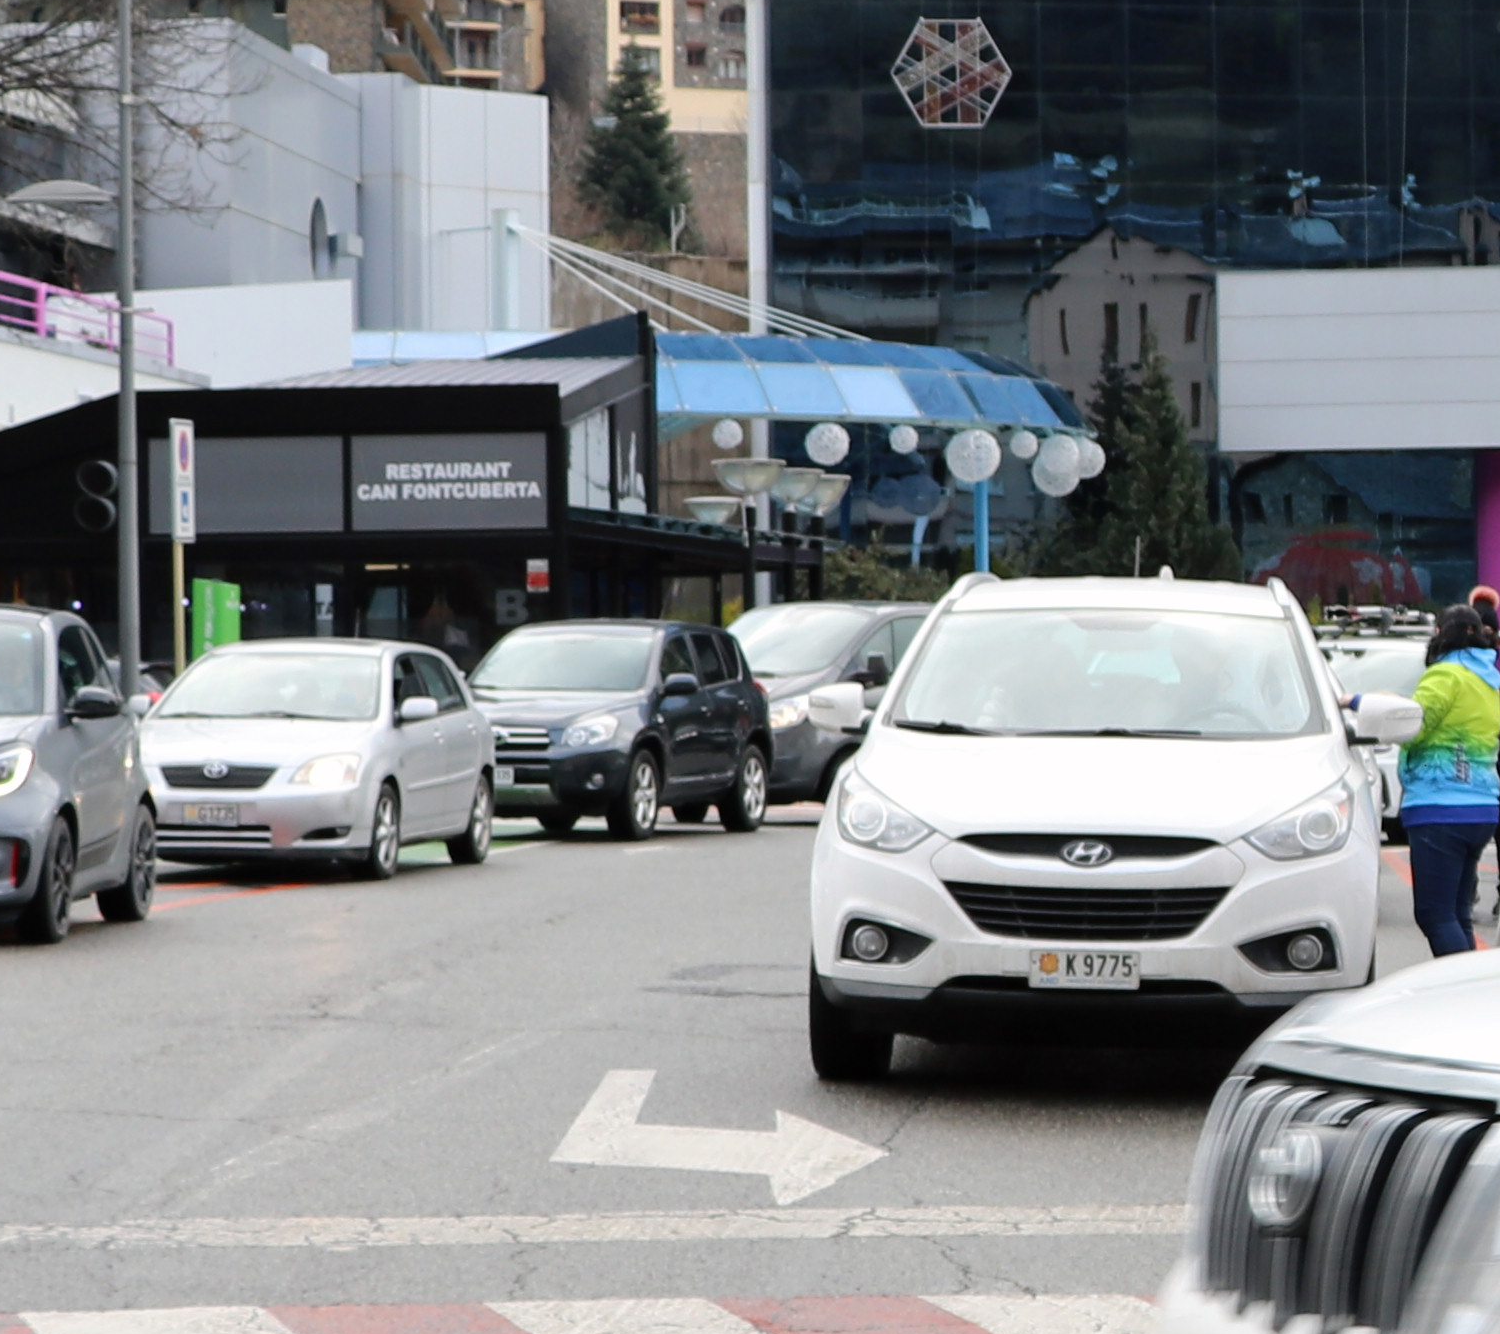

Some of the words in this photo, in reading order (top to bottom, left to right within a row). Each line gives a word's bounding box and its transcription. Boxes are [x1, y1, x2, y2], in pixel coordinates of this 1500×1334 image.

[385, 462, 512, 481] RESTAURANT
[357, 484, 398, 501] CAN
[402, 481, 542, 500] FONTCUBERTA
[1065, 953, 1077, 976] K
[1083, 953, 1133, 978] 9775
